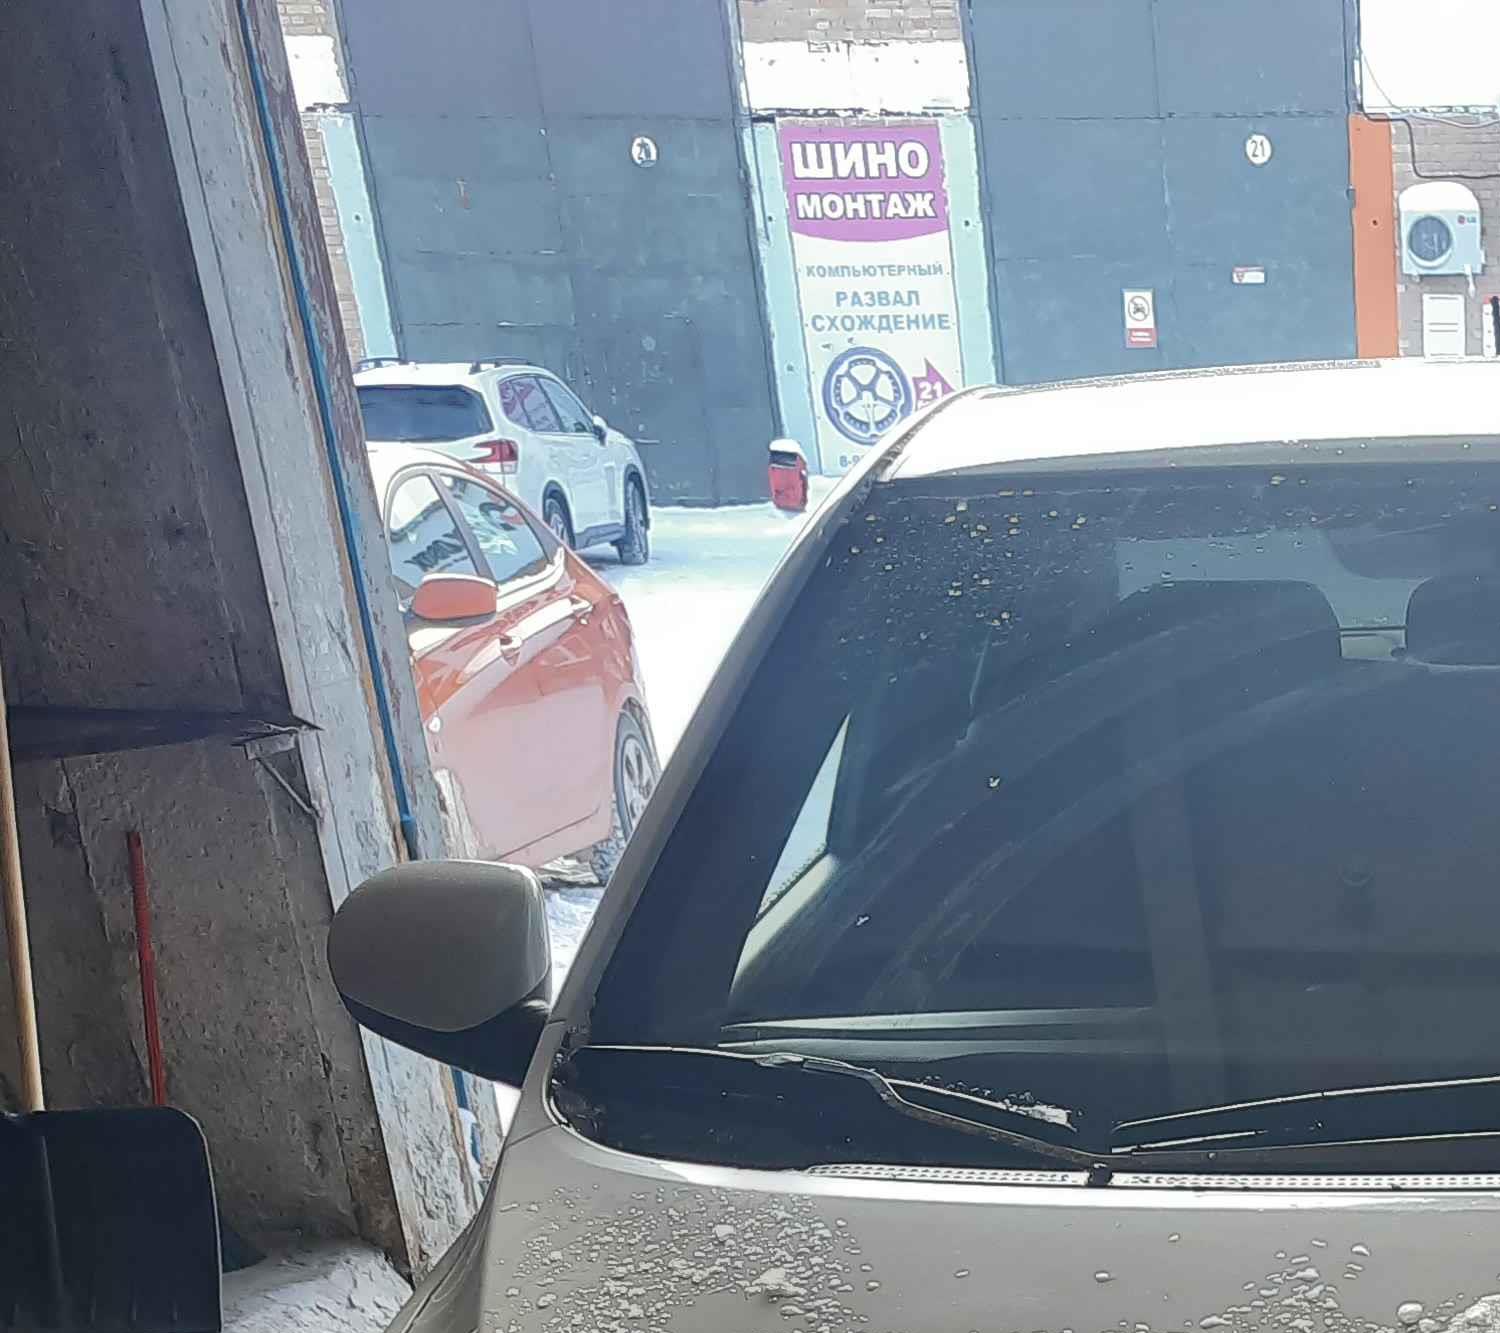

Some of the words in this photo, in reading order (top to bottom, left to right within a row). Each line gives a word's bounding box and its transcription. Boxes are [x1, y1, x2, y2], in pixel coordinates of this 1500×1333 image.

[1250, 139, 1266, 158] 21
[789, 141, 930, 180] ШИНО
[794, 191, 936, 221] МОНТАЖ
[805, 261, 945, 279] КОМПЬЮТЕРНЫЙ
[834, 290, 921, 309] РАЗВАЛ
[810, 313, 951, 334] СХОЖДЕНИЕ
[919, 380, 943, 400] 21
